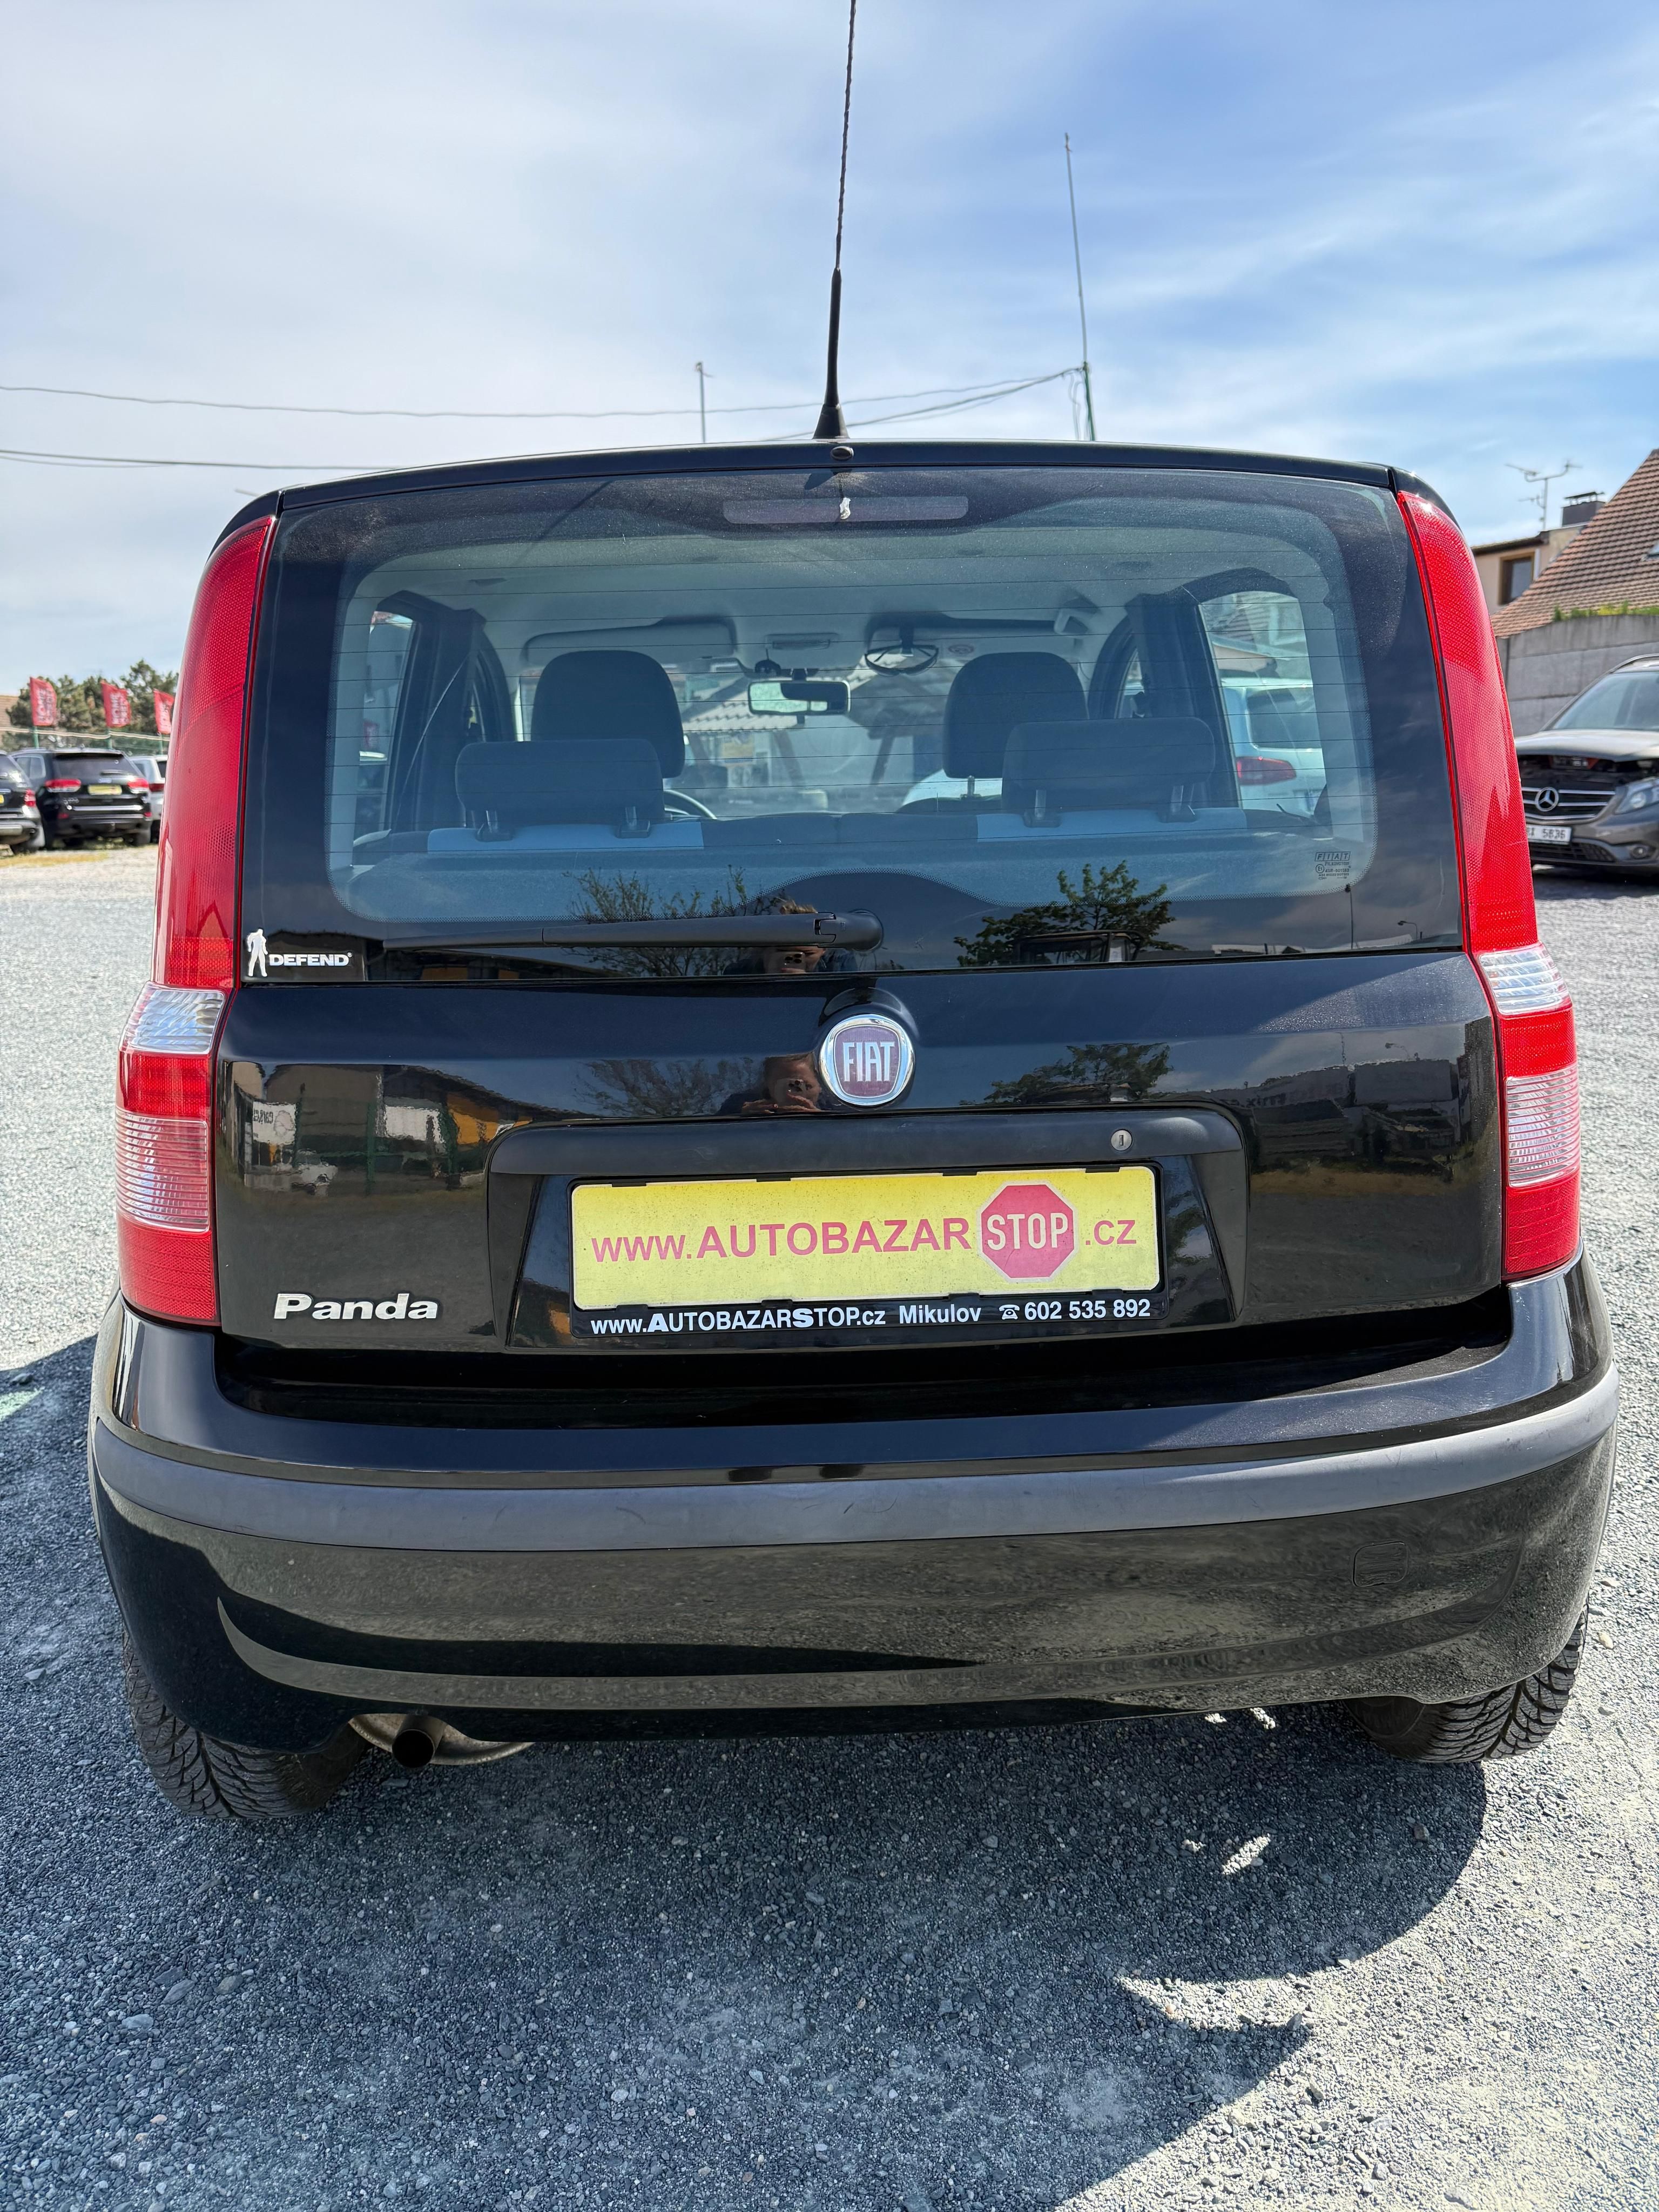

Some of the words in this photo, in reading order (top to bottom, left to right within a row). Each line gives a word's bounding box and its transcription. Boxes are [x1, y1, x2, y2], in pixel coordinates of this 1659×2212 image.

[1316, 853, 1350, 861] FIAT
[269, 954, 350, 967] DEFEND
[842, 1041, 895, 1082] FIAT
[987, 1212, 1068, 1250] STOP
[274, 1293, 438, 1319] Panda
[899, 1304, 982, 1324] Mikulov
[1024, 1301, 1062, 1320] 602
[1069, 1300, 1107, 1319] 535
[1113, 1298, 1151, 1318] 892
